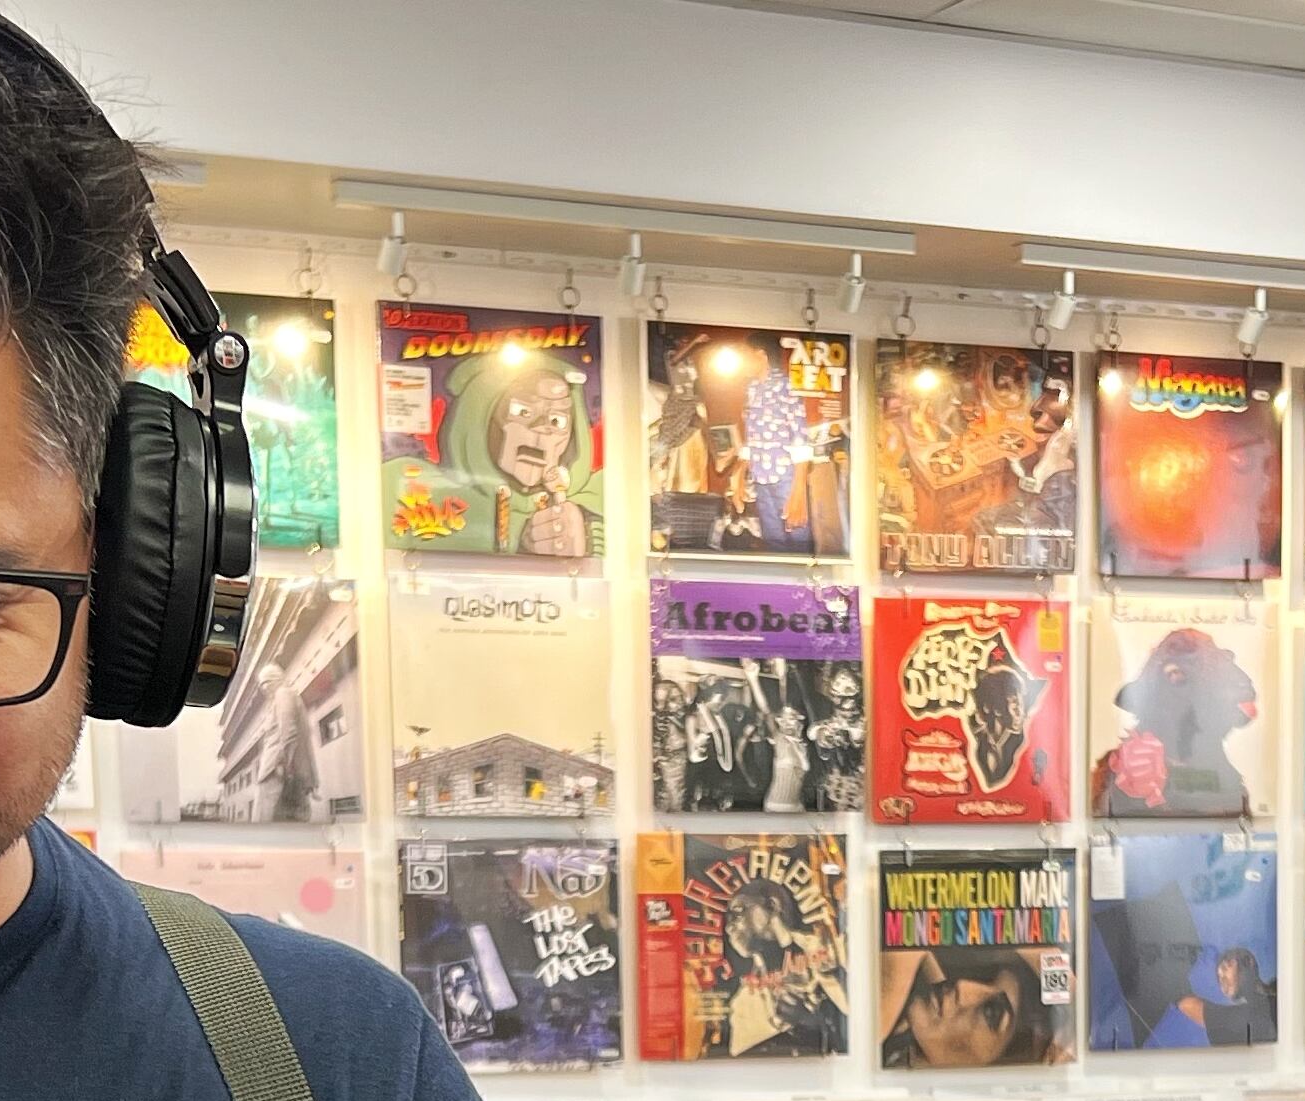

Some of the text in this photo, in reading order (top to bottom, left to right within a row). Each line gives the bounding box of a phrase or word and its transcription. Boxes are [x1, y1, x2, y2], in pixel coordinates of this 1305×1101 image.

[885, 869, 1016, 911] WATERMELON
[534, 922, 594, 960] LOST
[885, 907, 1071, 947] MONGO SANTAMARIA
